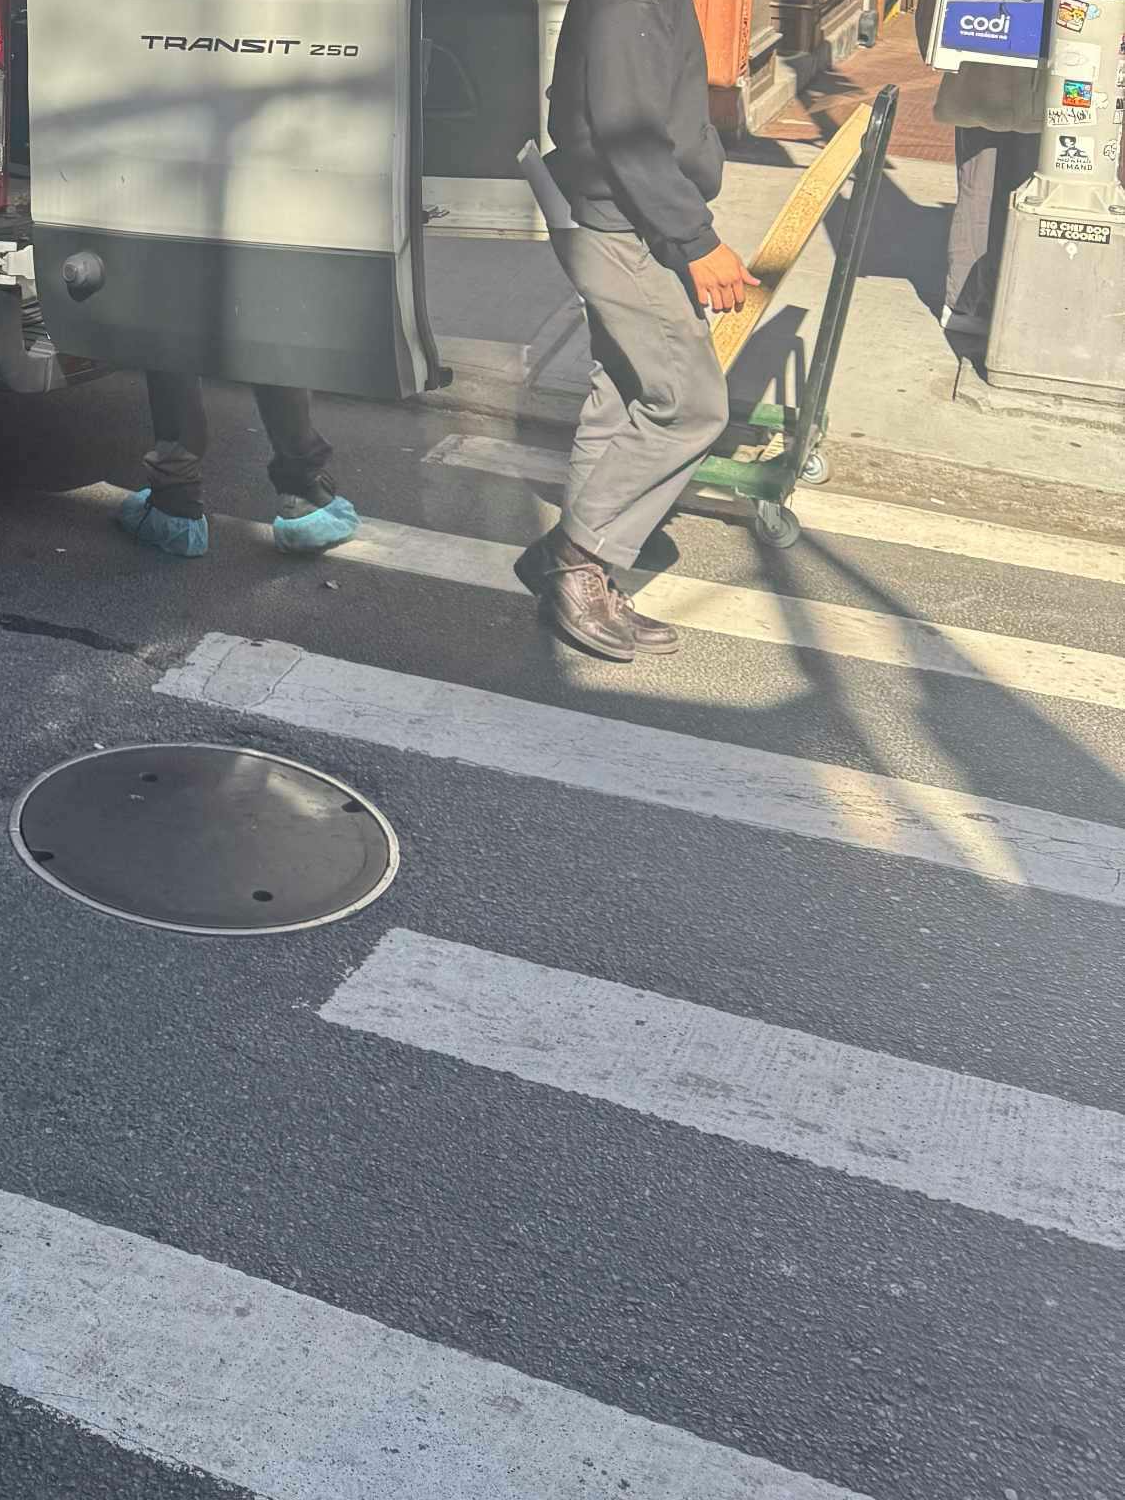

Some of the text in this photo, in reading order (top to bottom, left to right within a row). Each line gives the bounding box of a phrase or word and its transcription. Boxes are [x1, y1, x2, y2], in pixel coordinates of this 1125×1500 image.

[960, 13, 1010, 34] codi
[141, 35, 359, 57] TRANSIT 250
[1039, 228, 1063, 238] STAY
